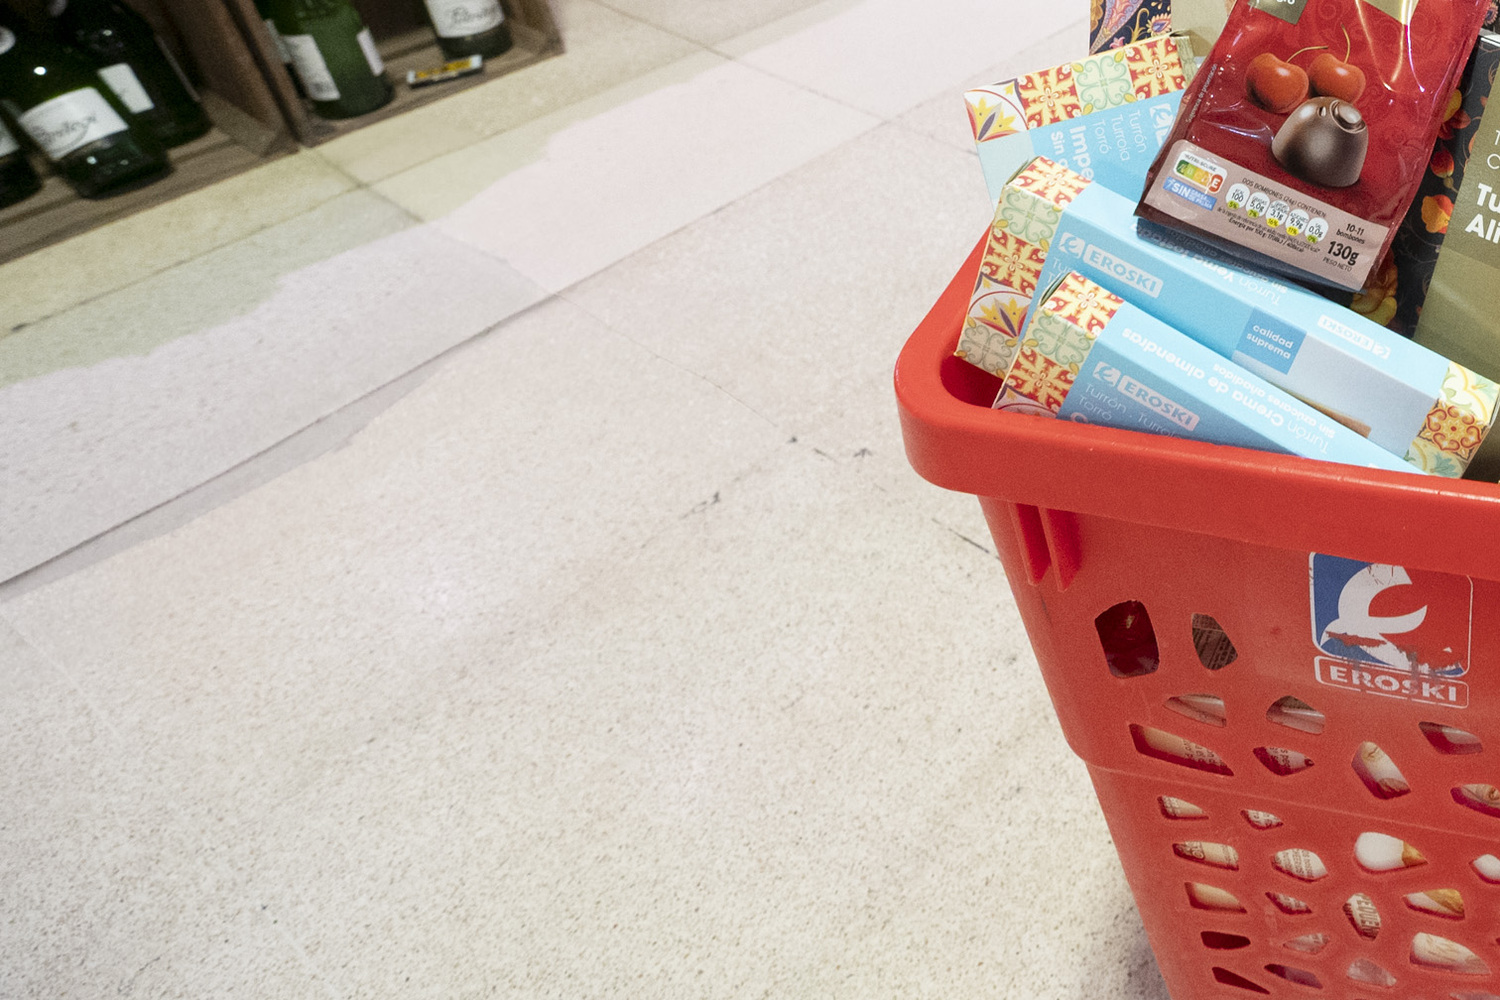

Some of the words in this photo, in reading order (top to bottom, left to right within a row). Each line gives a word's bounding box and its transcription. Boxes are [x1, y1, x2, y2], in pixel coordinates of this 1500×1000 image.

[1050, 131, 1065, 156] Sin
[1092, 118, 1112, 155] Torró
[1111, 114, 1130, 162] Turroia
[1129, 110, 1147, 153] Turrón
[1172, 182, 1188, 198] SIN
[1213, 179, 1221, 188] E
[1232, 193, 1243, 202] 100
[1242, 178, 1253, 187] DOS
[1255, 183, 1283, 199] BOMBONES
[1298, 201, 1327, 217] CONTIENEN
[1250, 200, 1264, 212] 5,0g
[1270, 209, 1283, 221] 3,1g
[1290, 217, 1303, 229] 9,9g
[1309, 225, 1323, 239] 0,0g
[1336, 229, 1365, 245] bombones
[1346, 223, 1365, 236] 10-11
[1191, 252, 1235, 282] Yema
[1323, 257, 1337, 268] PESO
[1337, 262, 1352, 272] NETO
[1328, 240, 1360, 266] 130g
[1089, 251, 1158, 291] EROSKI
[1239, 276, 1280, 306] Turrón
[1246, 332, 1292, 360] suprema
[1252, 323, 1294, 349] calidad
[1122, 327, 1205, 380] almendras
[1207, 372, 1230, 394] de
[1212, 362, 1266, 397] añadidos
[1078, 394, 1113, 423] Torró
[1083, 383, 1128, 413] Turrón
[1119, 382, 1195, 428] EROSKI
[1231, 390, 1284, 427] Crema
[1267, 392, 1318, 427] azúcares
[1287, 421, 1329, 455] Turrón
[1319, 422, 1336, 438] Sin
[1329, 665, 1457, 702] EROSKI
